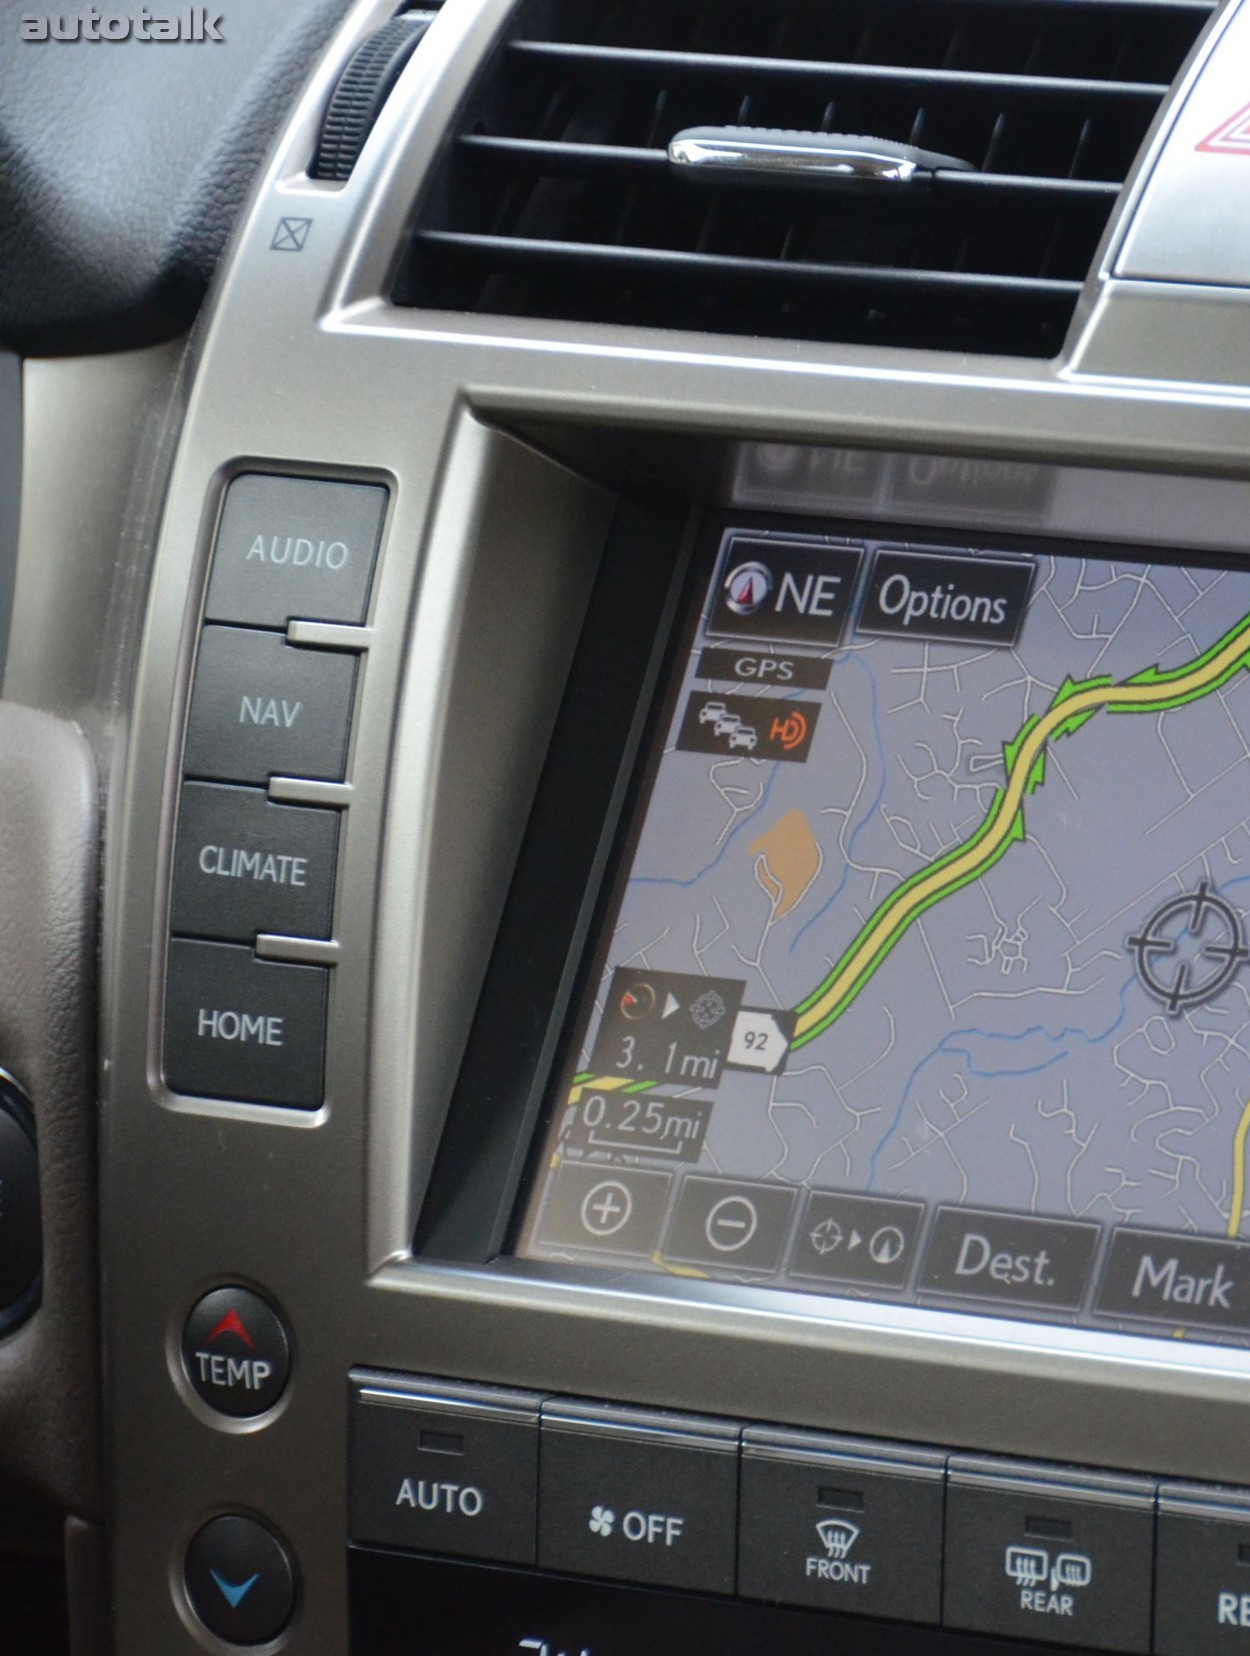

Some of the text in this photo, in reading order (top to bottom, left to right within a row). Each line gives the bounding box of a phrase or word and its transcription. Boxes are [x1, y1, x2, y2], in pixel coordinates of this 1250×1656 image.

[246, 534, 349, 570] AUDIO
[774, 574, 841, 618] NE
[878, 574, 1007, 626] Options
[734, 657, 794, 680] GPS
[239, 697, 300, 728] NAV
[199, 845, 307, 887] CLIMATE
[197, 1008, 282, 1047] HOME
[744, 1031, 768, 1051] 92
[955, 1233, 1055, 1287] Dest.
[1131, 1255, 1234, 1309] Mark
[196, 1351, 272, 1391] TEMP
[396, 1478, 483, 1516] AUTO
[622, 1511, 684, 1546] OFF
[806, 1557, 870, 1585] FRONT
[1020, 1590, 1074, 1616] REAR
